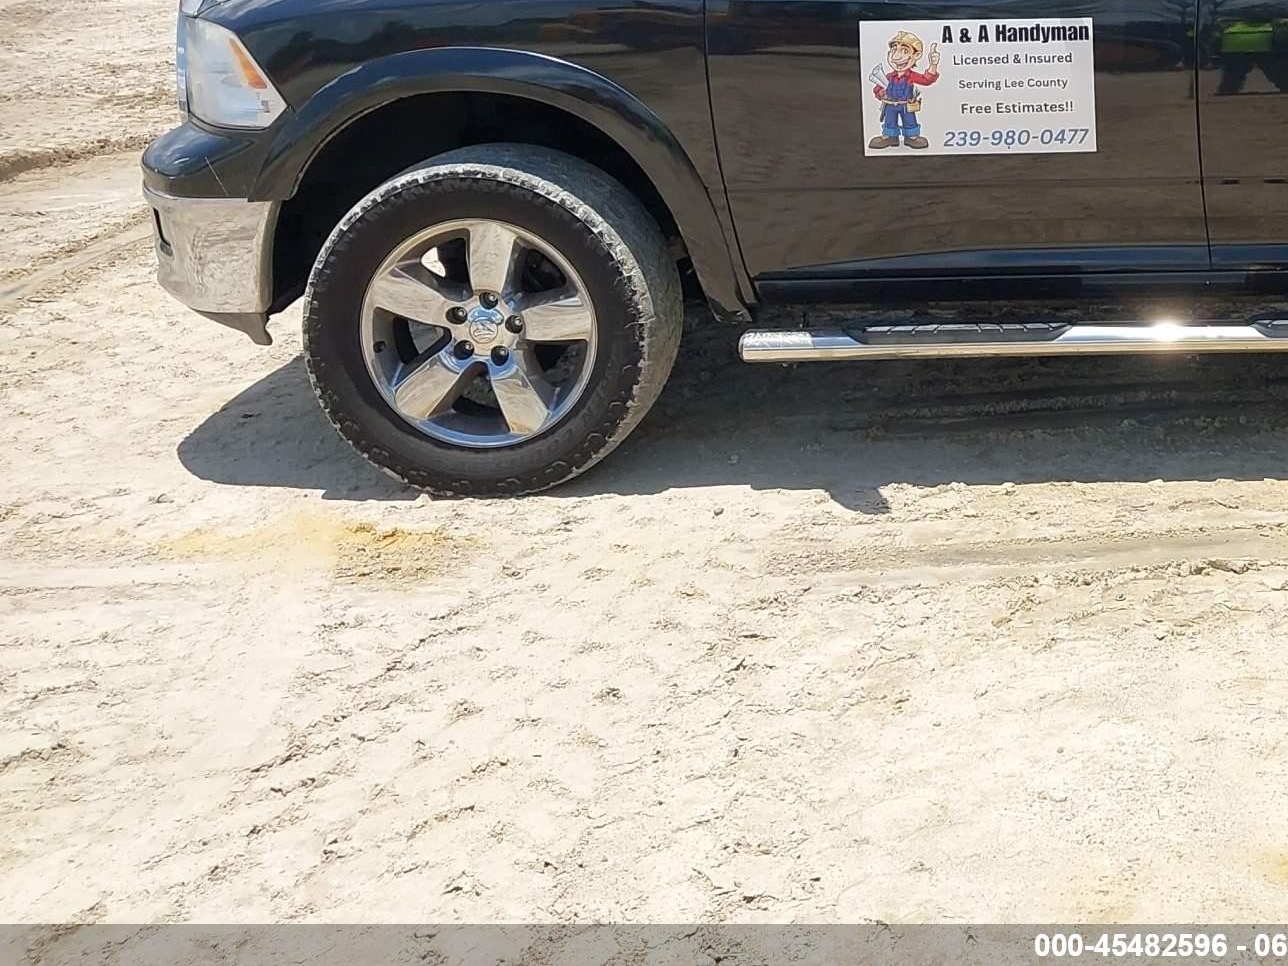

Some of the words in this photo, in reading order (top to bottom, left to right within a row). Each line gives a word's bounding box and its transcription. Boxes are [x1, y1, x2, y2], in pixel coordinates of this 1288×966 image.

[942, 26, 953, 43] A
[959, 27, 972, 43] &
[978, 25, 989, 42] A
[996, 23, 1090, 43] Handyman
[953, 54, 1009, 66] Licensed
[1013, 54, 1021, 64] &
[1025, 52, 1072, 64] Insured
[959, 79, 1001, 90] Serving
[1005, 79, 1024, 88] Lee
[1027, 78, 1068, 89] County
[961, 103, 991, 114] Free
[996, 102, 1074, 113] Estimates!!
[944, 129, 1089, 147] 239-980-0477
